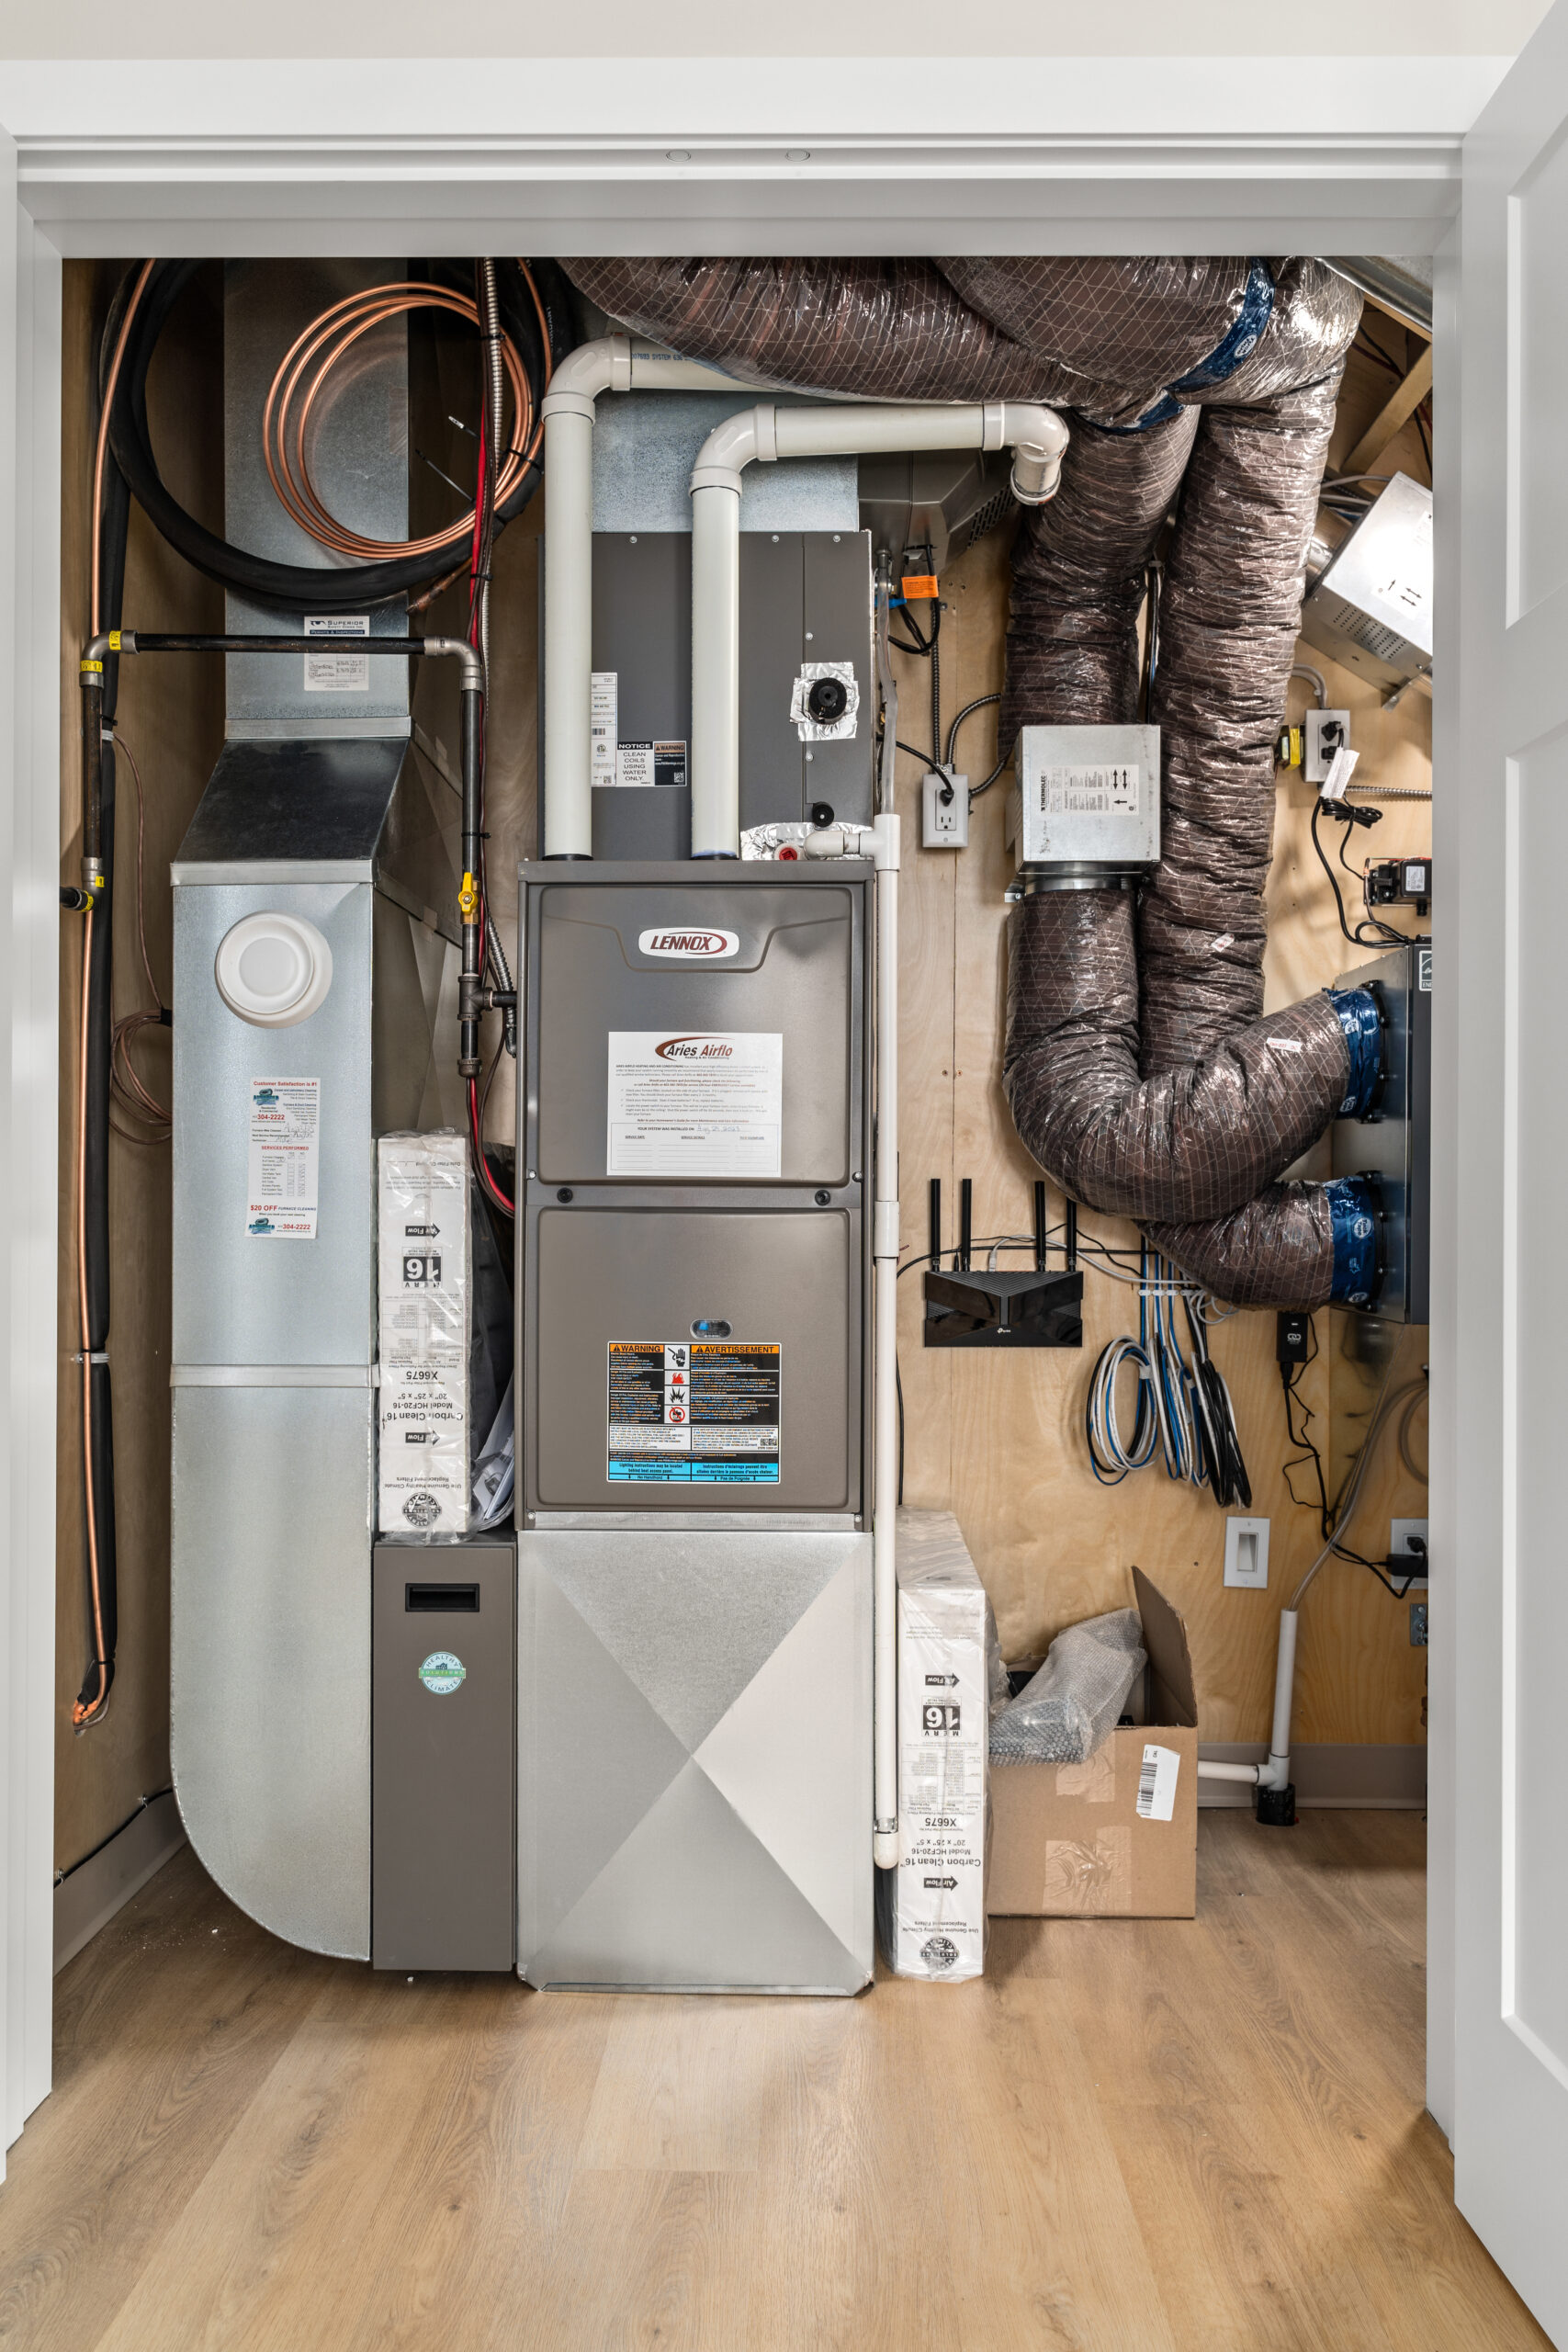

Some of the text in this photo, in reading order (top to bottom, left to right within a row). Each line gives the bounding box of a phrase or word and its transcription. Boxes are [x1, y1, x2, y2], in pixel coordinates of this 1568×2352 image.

[650, 935, 713, 951] LENNOX
[666, 1043, 733, 1057] Aries Airflo
[406, 1258, 439, 1279] 16
[406, 1370, 438, 1380] X6675
[399, 1412, 426, 1421] Clean
[426, 1654, 459, 1668] HEALTHY
[427, 1680, 458, 1692] CLIMATE
[925, 1707, 959, 1728] 16
[925, 1817, 957, 1826] X6675
[917, 1858, 944, 1867] Clean
[947, 1858, 981, 1867] Carbon
